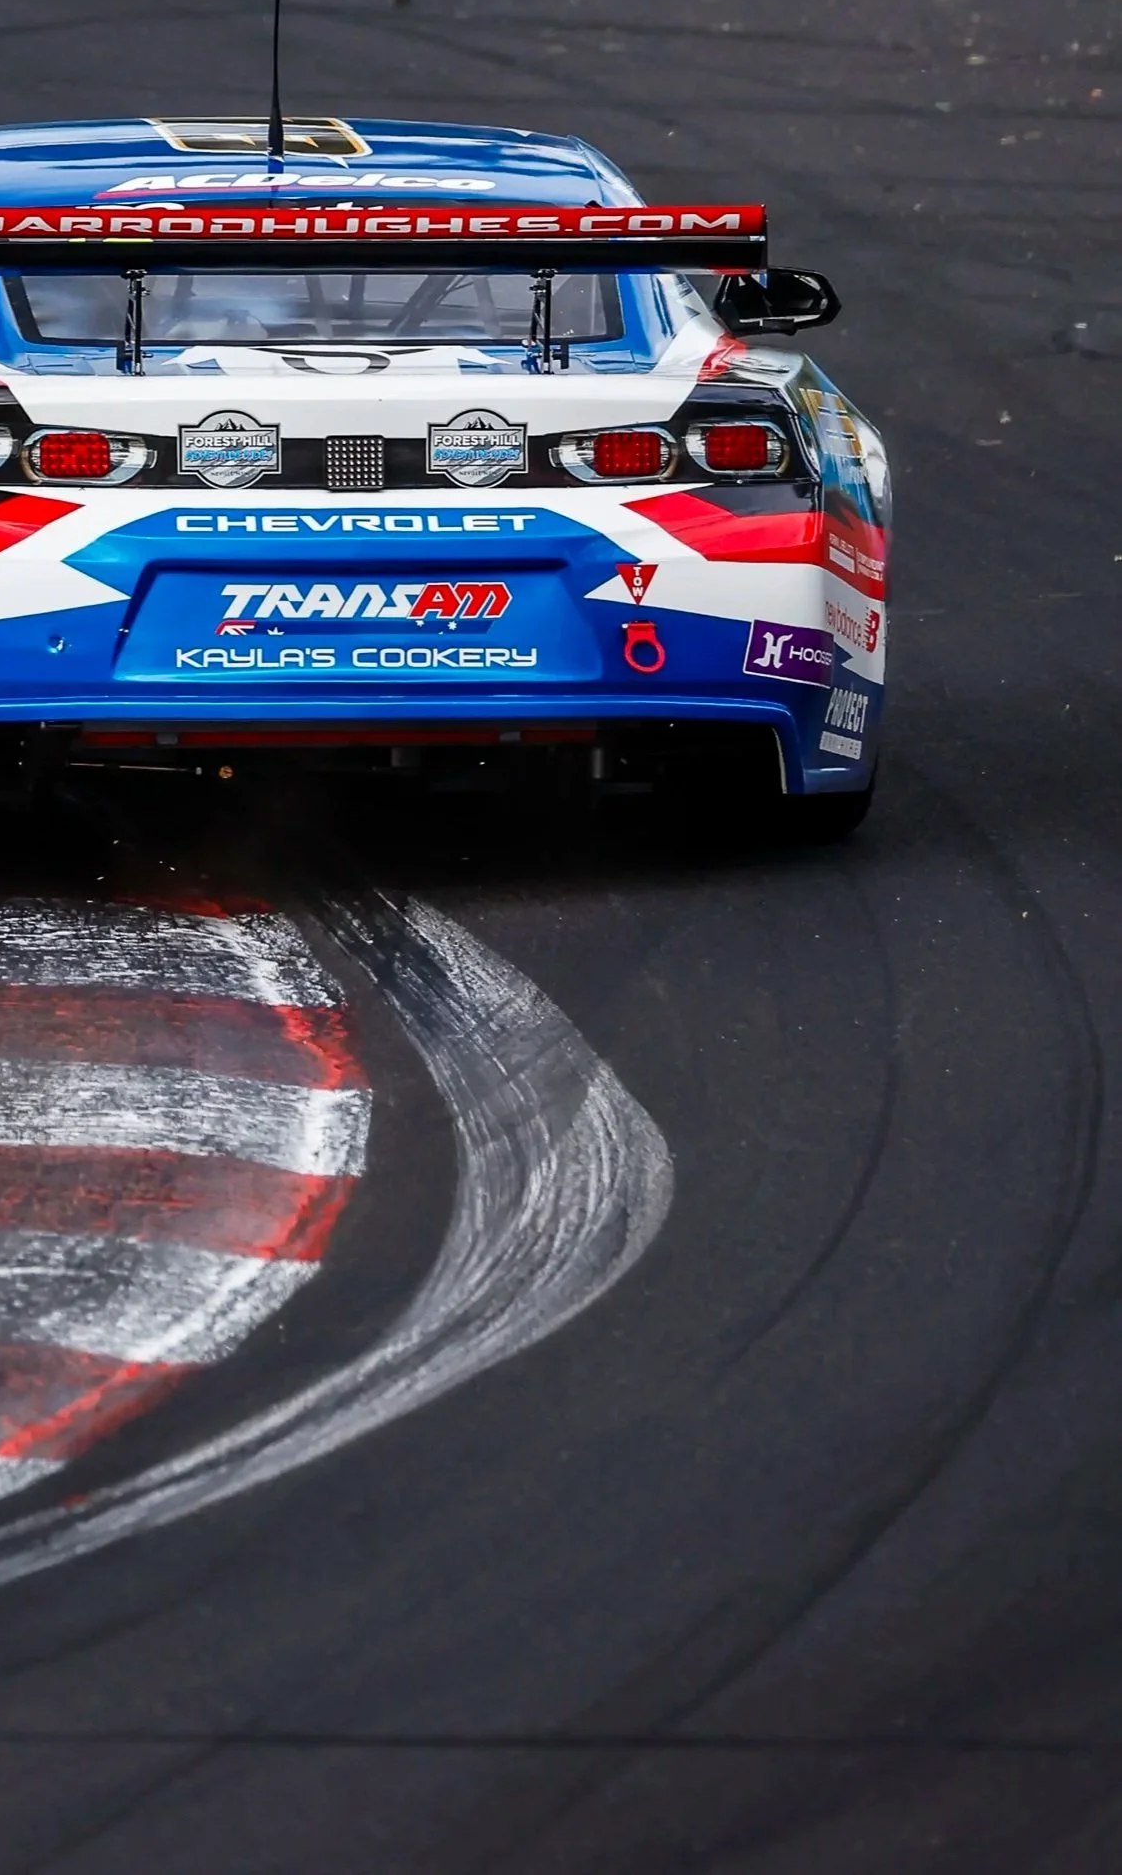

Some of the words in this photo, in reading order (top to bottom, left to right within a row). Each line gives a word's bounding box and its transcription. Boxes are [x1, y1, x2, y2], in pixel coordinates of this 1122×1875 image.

[185, 436, 239, 447] FOREST
[242, 435, 273, 446] HILL
[434, 435, 488, 446] FOREST
[490, 435, 520, 446] HILL
[176, 515, 536, 532] CHEVROLET
[632, 566, 644, 597] TOW
[176, 648, 336, 668] KAYLA'S
[351, 648, 537, 668] COOKERY
